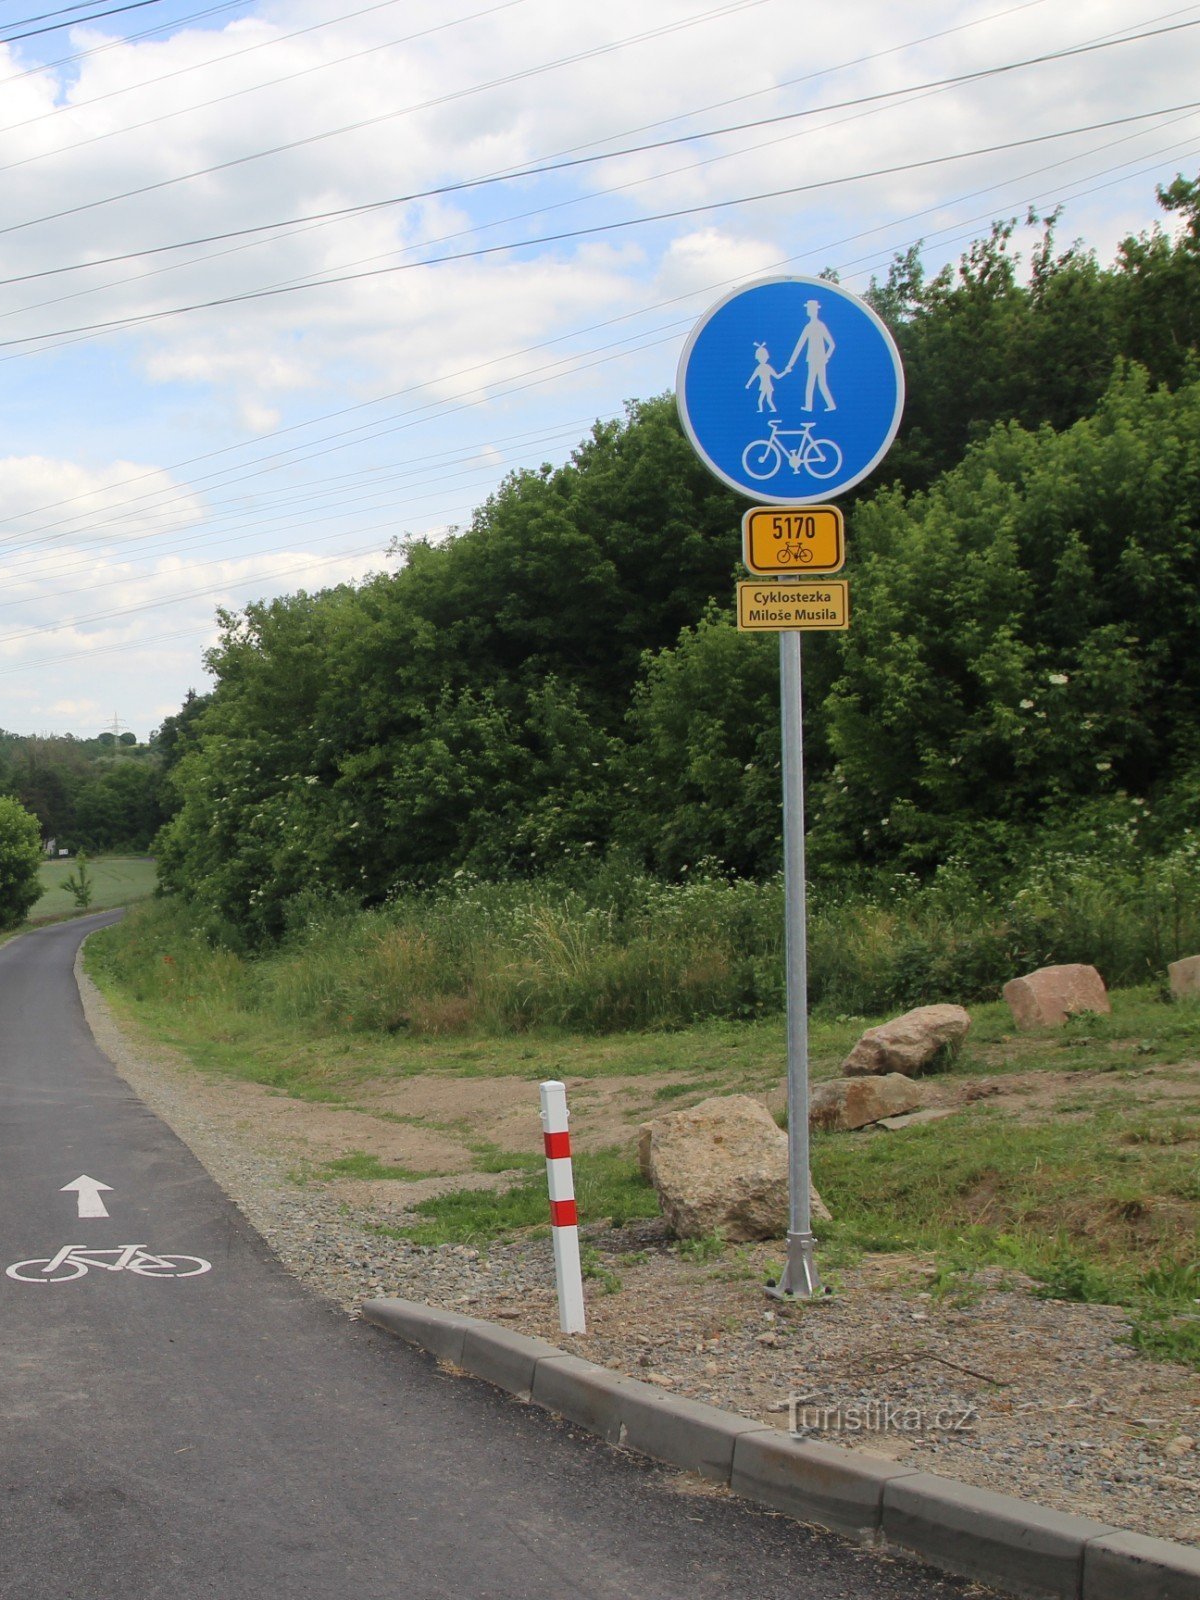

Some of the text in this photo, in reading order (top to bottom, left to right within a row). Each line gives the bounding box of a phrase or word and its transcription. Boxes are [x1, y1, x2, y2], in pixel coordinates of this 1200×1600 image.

[773, 517, 815, 539] 5170
[753, 591, 831, 605] Cyklostezka
[749, 608, 836, 621] Miloše Musila
